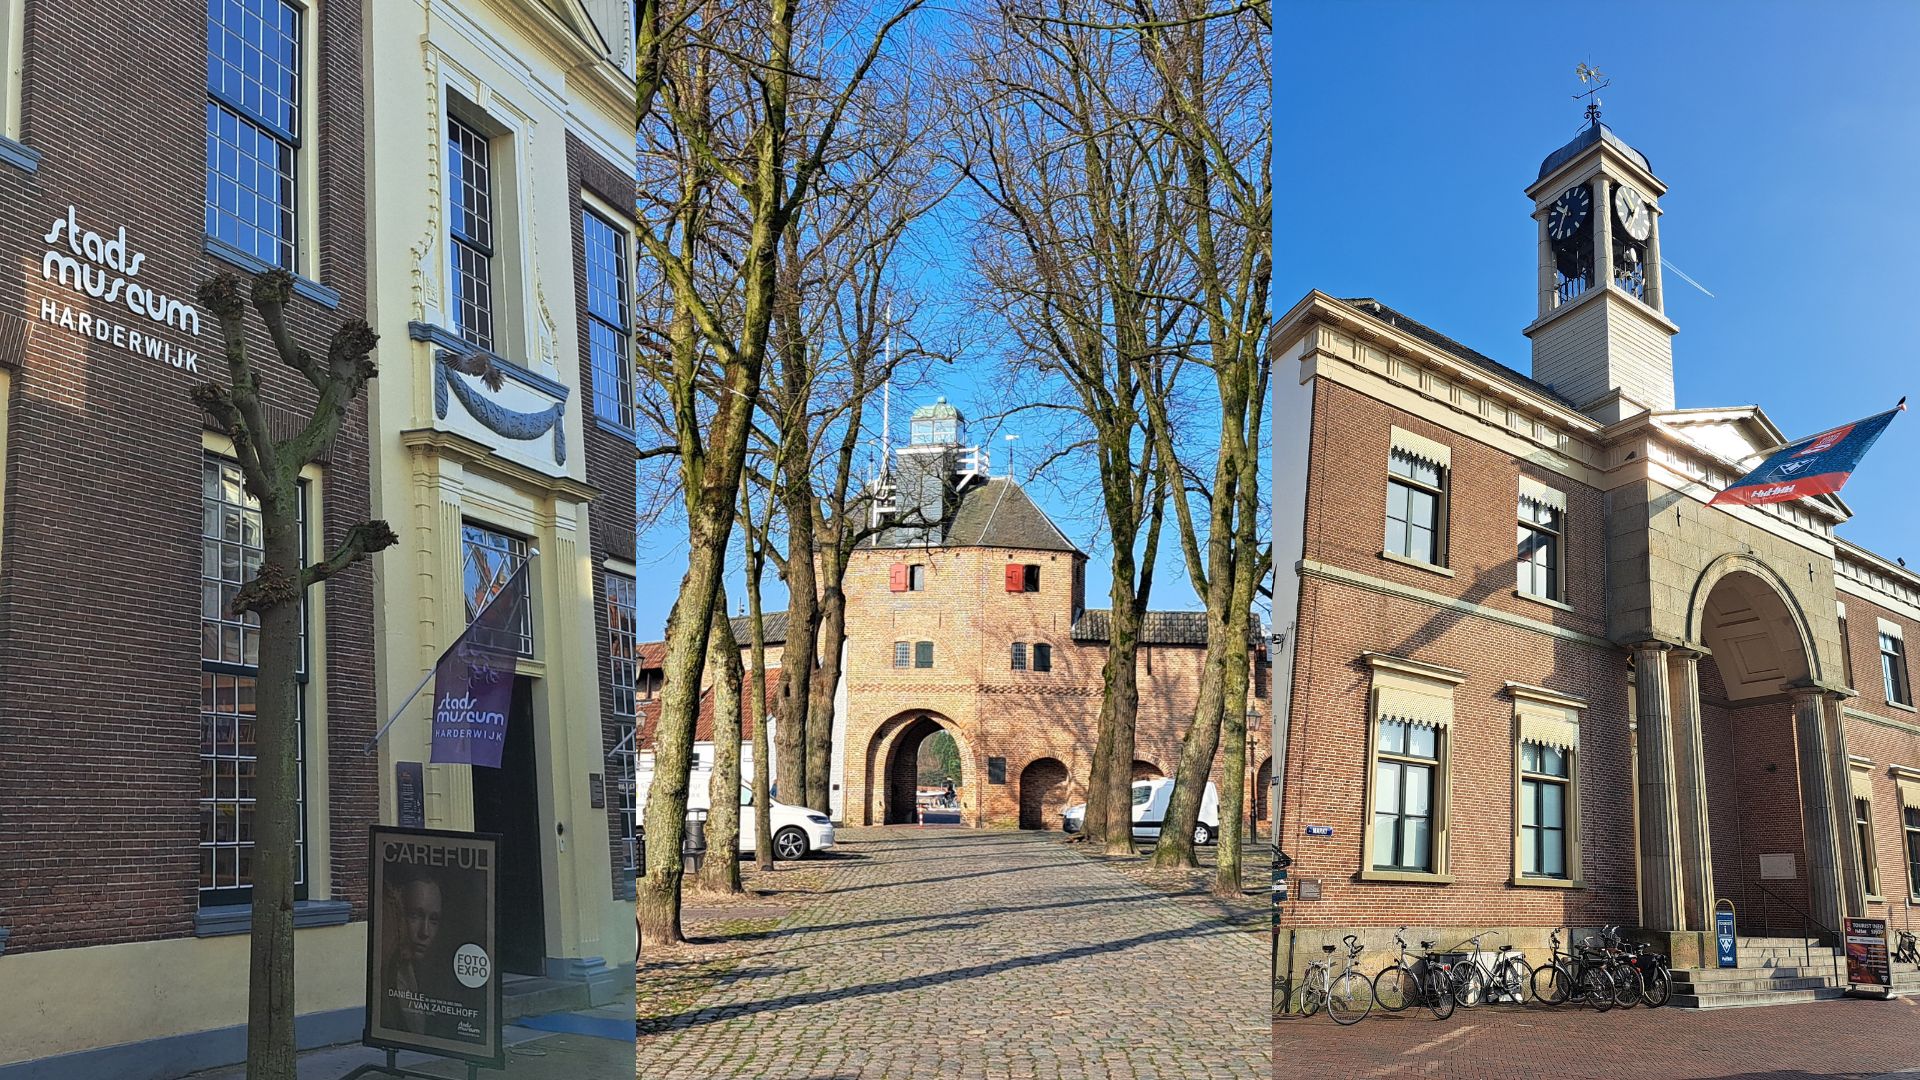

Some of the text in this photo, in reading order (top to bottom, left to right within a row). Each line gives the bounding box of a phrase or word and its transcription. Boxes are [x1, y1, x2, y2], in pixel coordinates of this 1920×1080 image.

[44, 204, 146, 276] stads
[42, 250, 199, 336] museum
[41, 298, 198, 373] HARDERWIJK
[438, 691, 477, 710] stads
[436, 711, 504, 726] museum
[435, 729, 502, 741] HARDERWIJK
[383, 842, 489, 871] CAREFUL
[457, 953, 488, 967] FOTO
[457, 964, 488, 978] EXPO
[413, 1001, 430, 1011] VAN
[431, 1003, 479, 1019] ZADELHOFF
